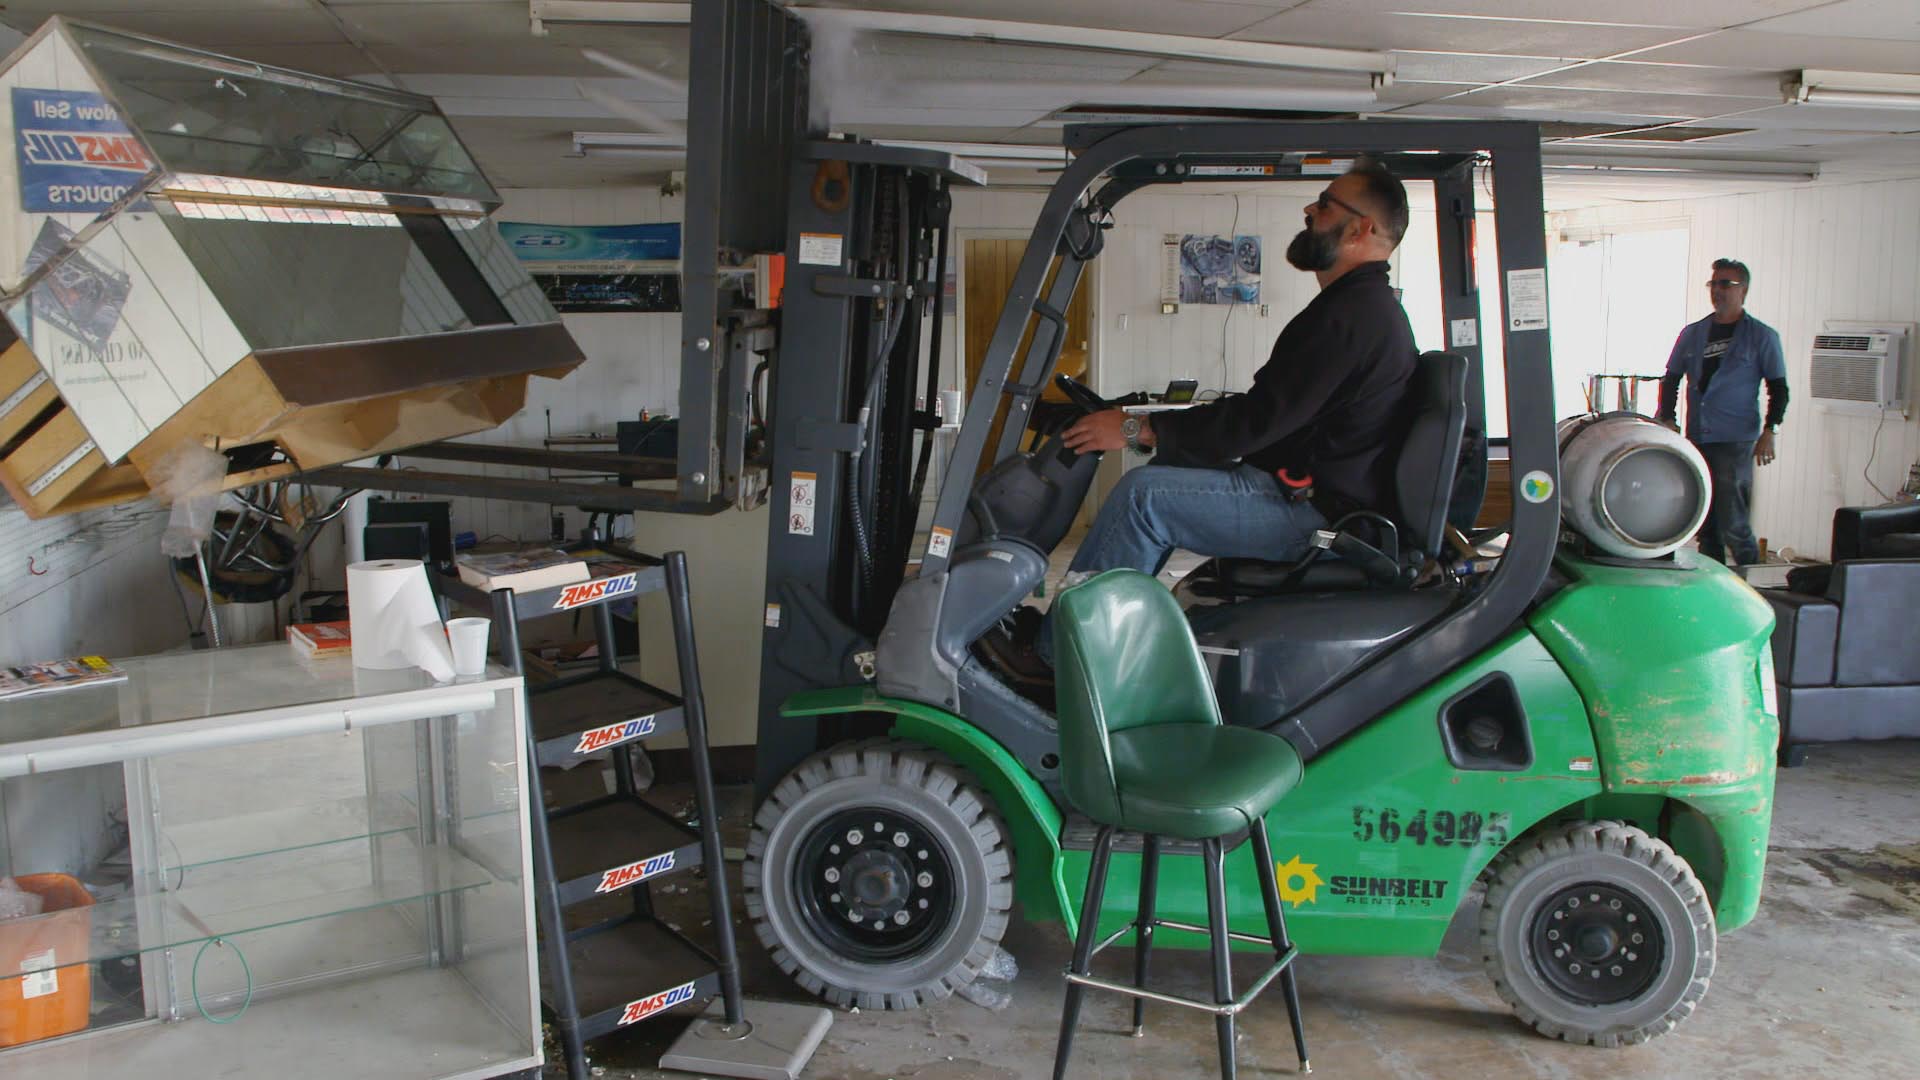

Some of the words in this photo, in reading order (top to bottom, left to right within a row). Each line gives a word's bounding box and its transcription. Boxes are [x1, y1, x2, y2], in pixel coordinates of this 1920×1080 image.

[560, 575, 635, 607] AMSOIL
[580, 716, 654, 751] AMSOIL
[1352, 806, 1509, 847] 564985
[600, 854, 673, 889] AMSOIL
[1330, 876, 1448, 899] SUNBELT
[622, 984, 694, 1021] AMSOIL
